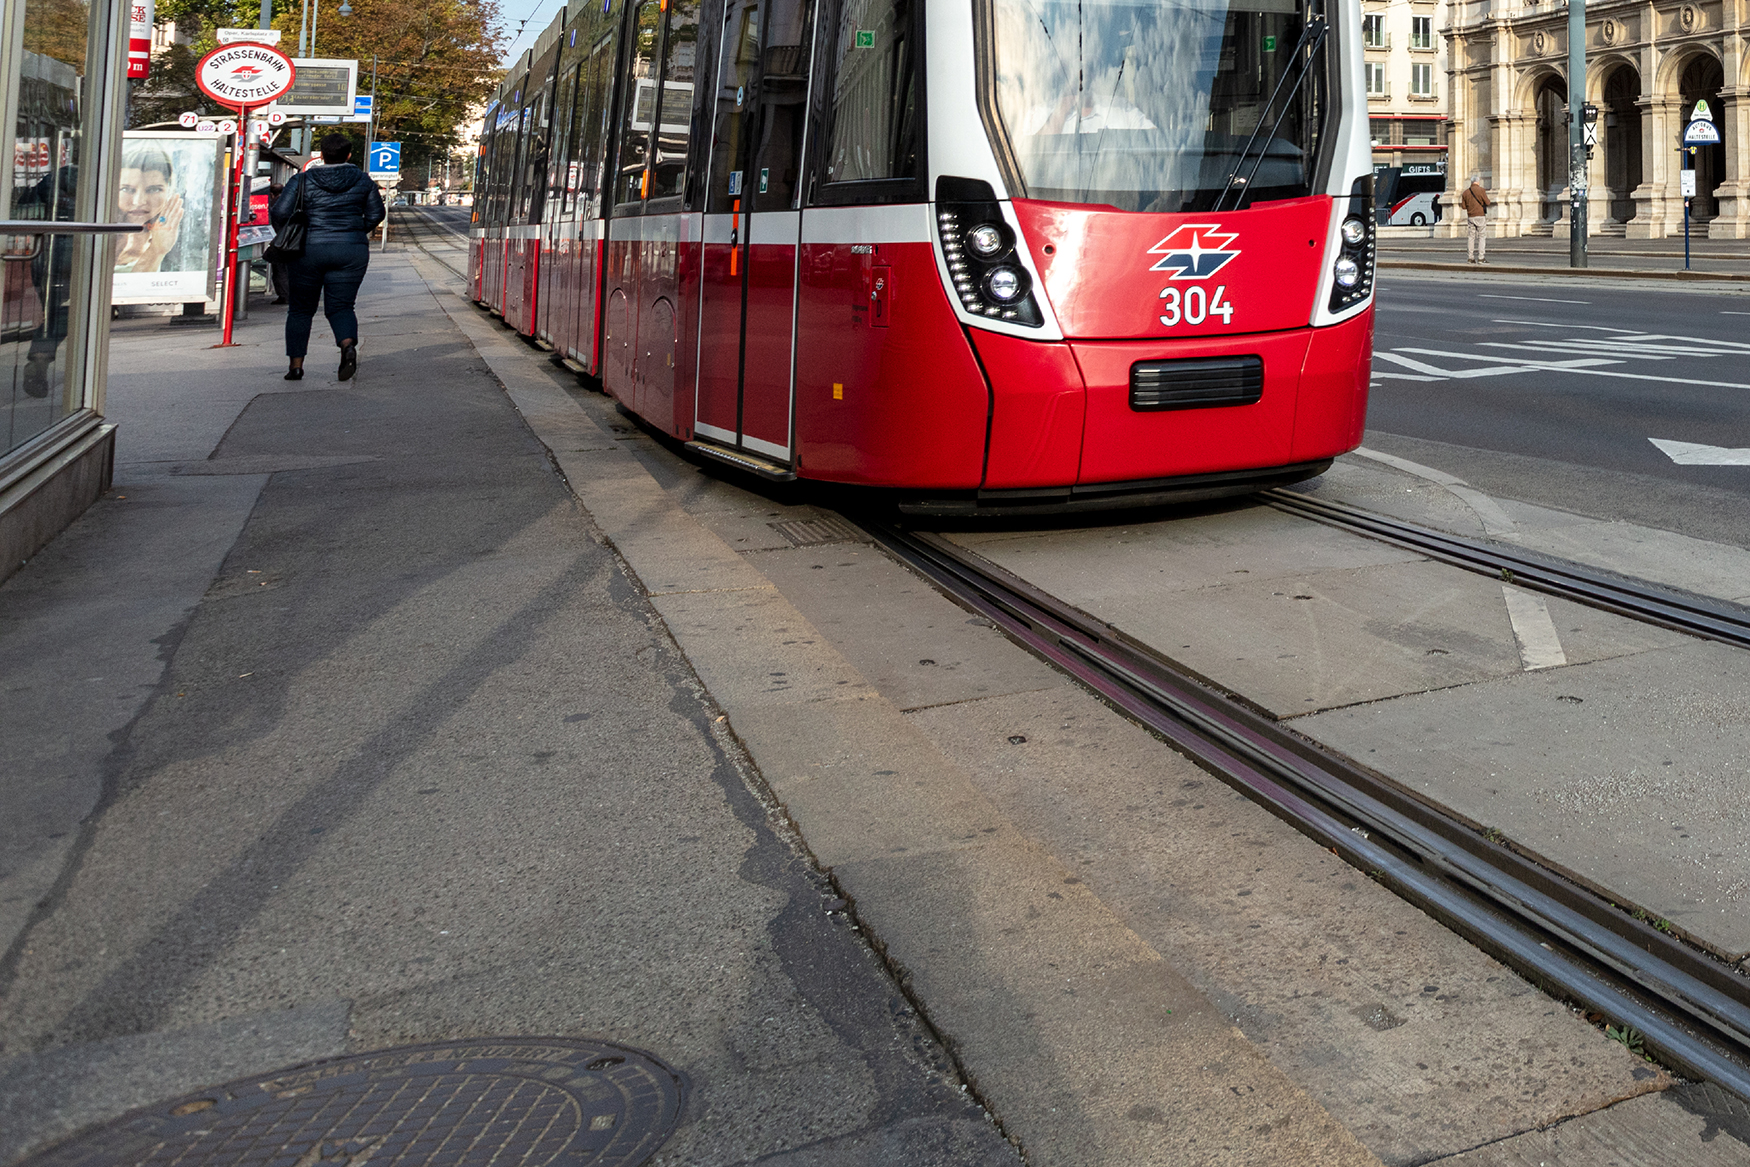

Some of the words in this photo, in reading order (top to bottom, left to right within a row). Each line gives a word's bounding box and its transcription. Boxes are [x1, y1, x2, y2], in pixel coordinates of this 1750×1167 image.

[209, 49, 286, 73] STRASSENBAHN
[210, 78, 280, 99] HALTESTELLE
[1699, 102, 1705, 110] H
[183, 115, 196, 124] 71
[272, 114, 282, 123] D
[223, 123, 231, 132] 2
[257, 123, 262, 131] 1
[379, 152, 392, 167] P
[1159, 285, 1234, 327] 304
